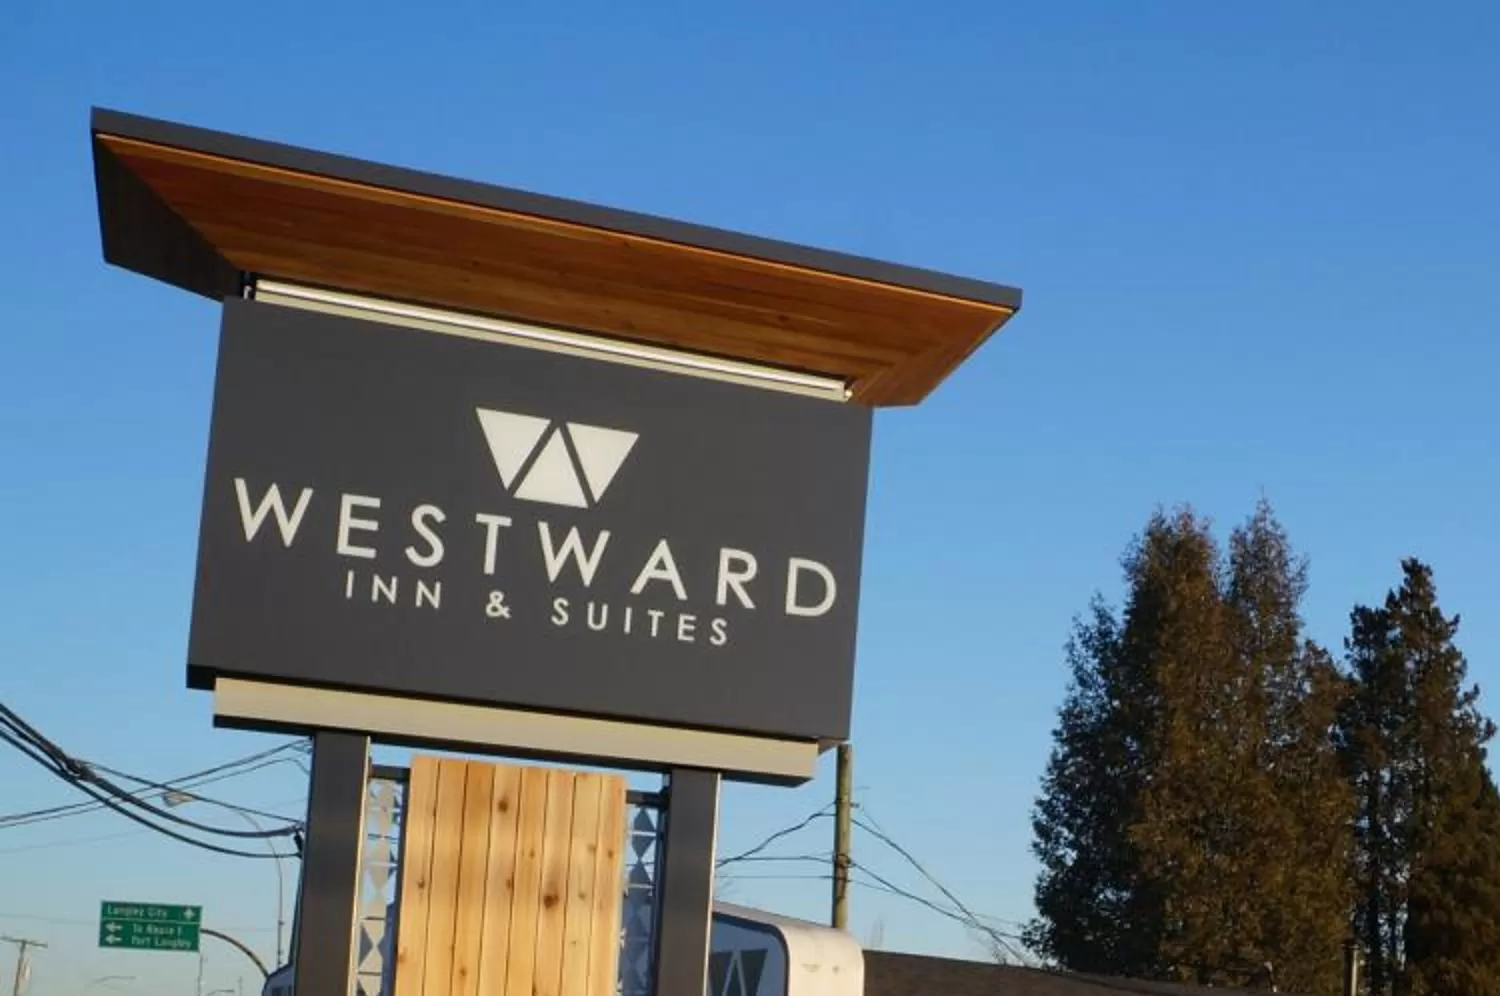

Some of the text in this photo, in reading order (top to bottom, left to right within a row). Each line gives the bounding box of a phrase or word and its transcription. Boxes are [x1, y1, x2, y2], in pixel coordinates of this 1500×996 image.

[234, 477, 838, 618] WESTWARD
[345, 570, 728, 646] INN & SUITES
